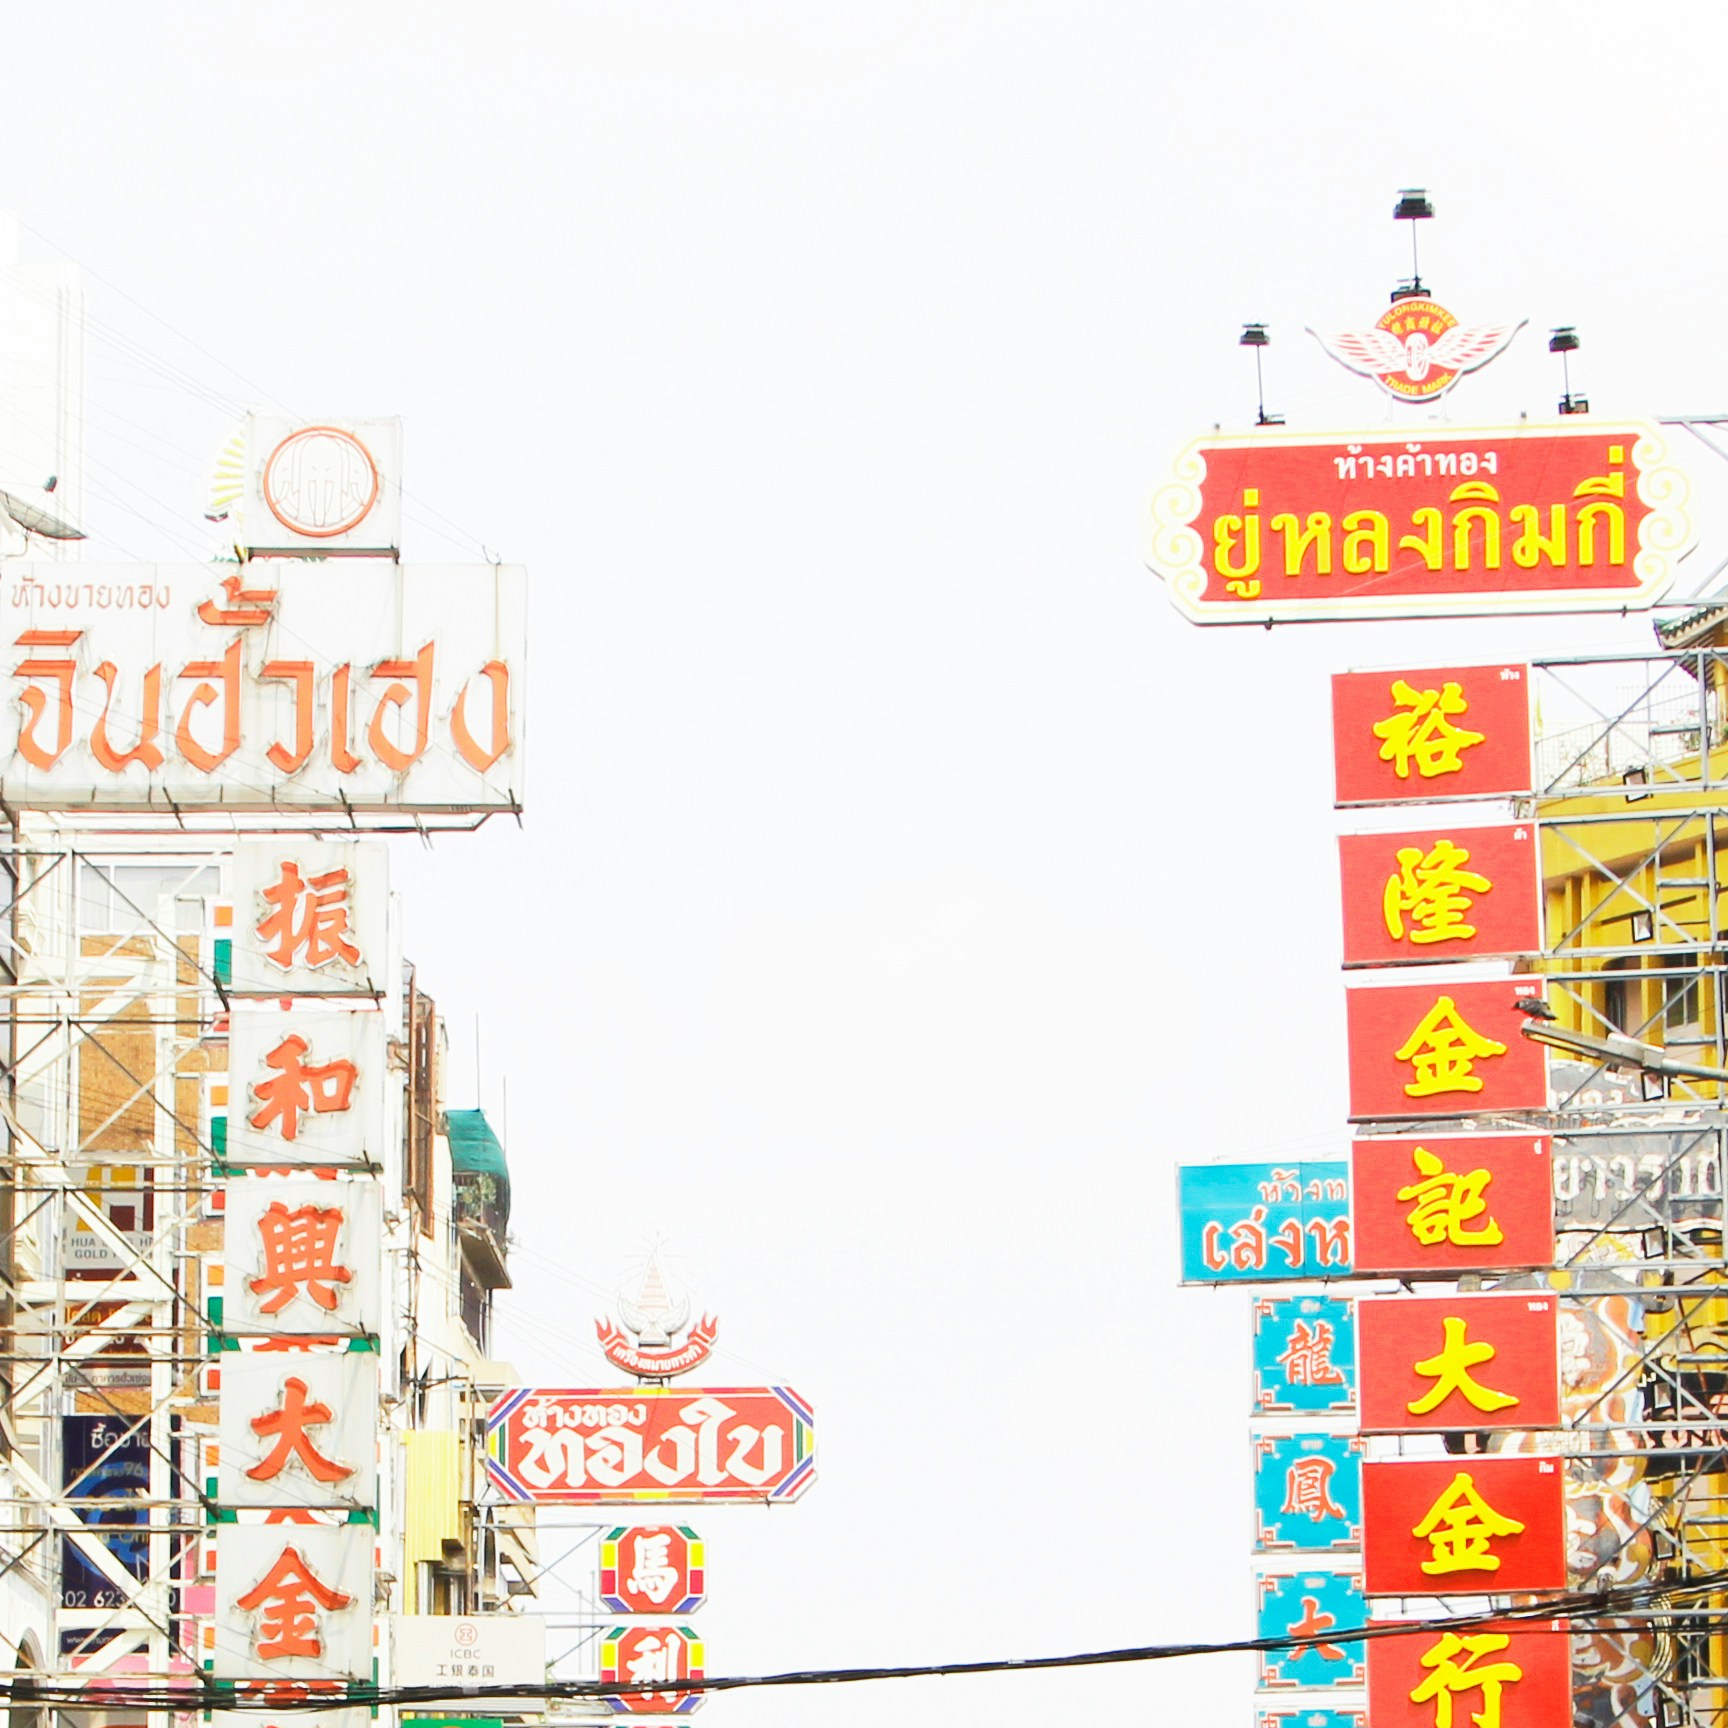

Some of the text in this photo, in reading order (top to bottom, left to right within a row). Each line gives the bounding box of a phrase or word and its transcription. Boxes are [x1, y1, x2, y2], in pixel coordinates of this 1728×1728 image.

[1386, 372, 1453, 395] TRADE MARK
[1334, 443, 1498, 479] ห้างค้าทอง
[1212, 445, 1627, 598] ยู่หลงกิมกี่
[11, 576, 170, 611] ห้างขายทอง
[1258, 1167, 1348, 1203] ห้างท
[1201, 1204, 1351, 1271] เล่งห
[522, 1396, 648, 1428] ห้างทอง
[518, 1396, 784, 1489] ทองใบ
[436, 1663, 495, 1678] 工银泰国
[450, 1649, 481, 1660] ICBC
